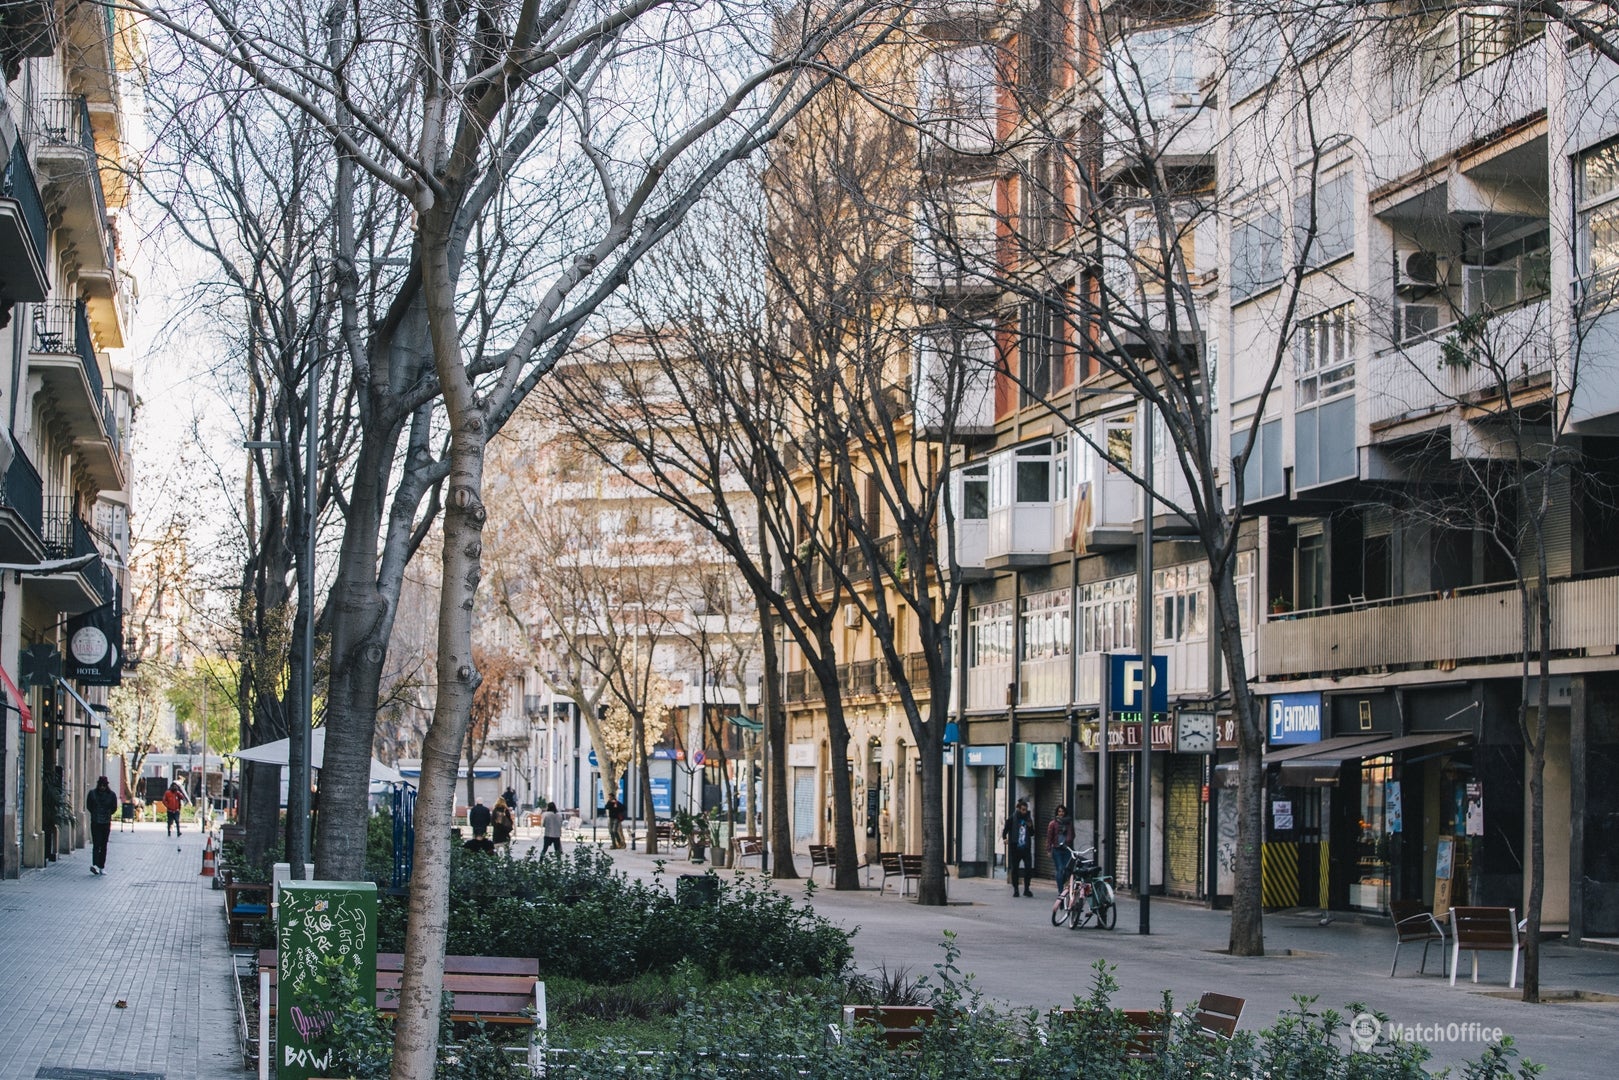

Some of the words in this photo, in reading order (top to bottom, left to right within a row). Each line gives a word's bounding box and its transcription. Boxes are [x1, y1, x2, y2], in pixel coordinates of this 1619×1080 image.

[1124, 661, 1157, 706] P
[1225, 720, 1235, 741] 89
[1272, 702, 1282, 737] P
[1284, 705, 1320, 732] ENTRADA
